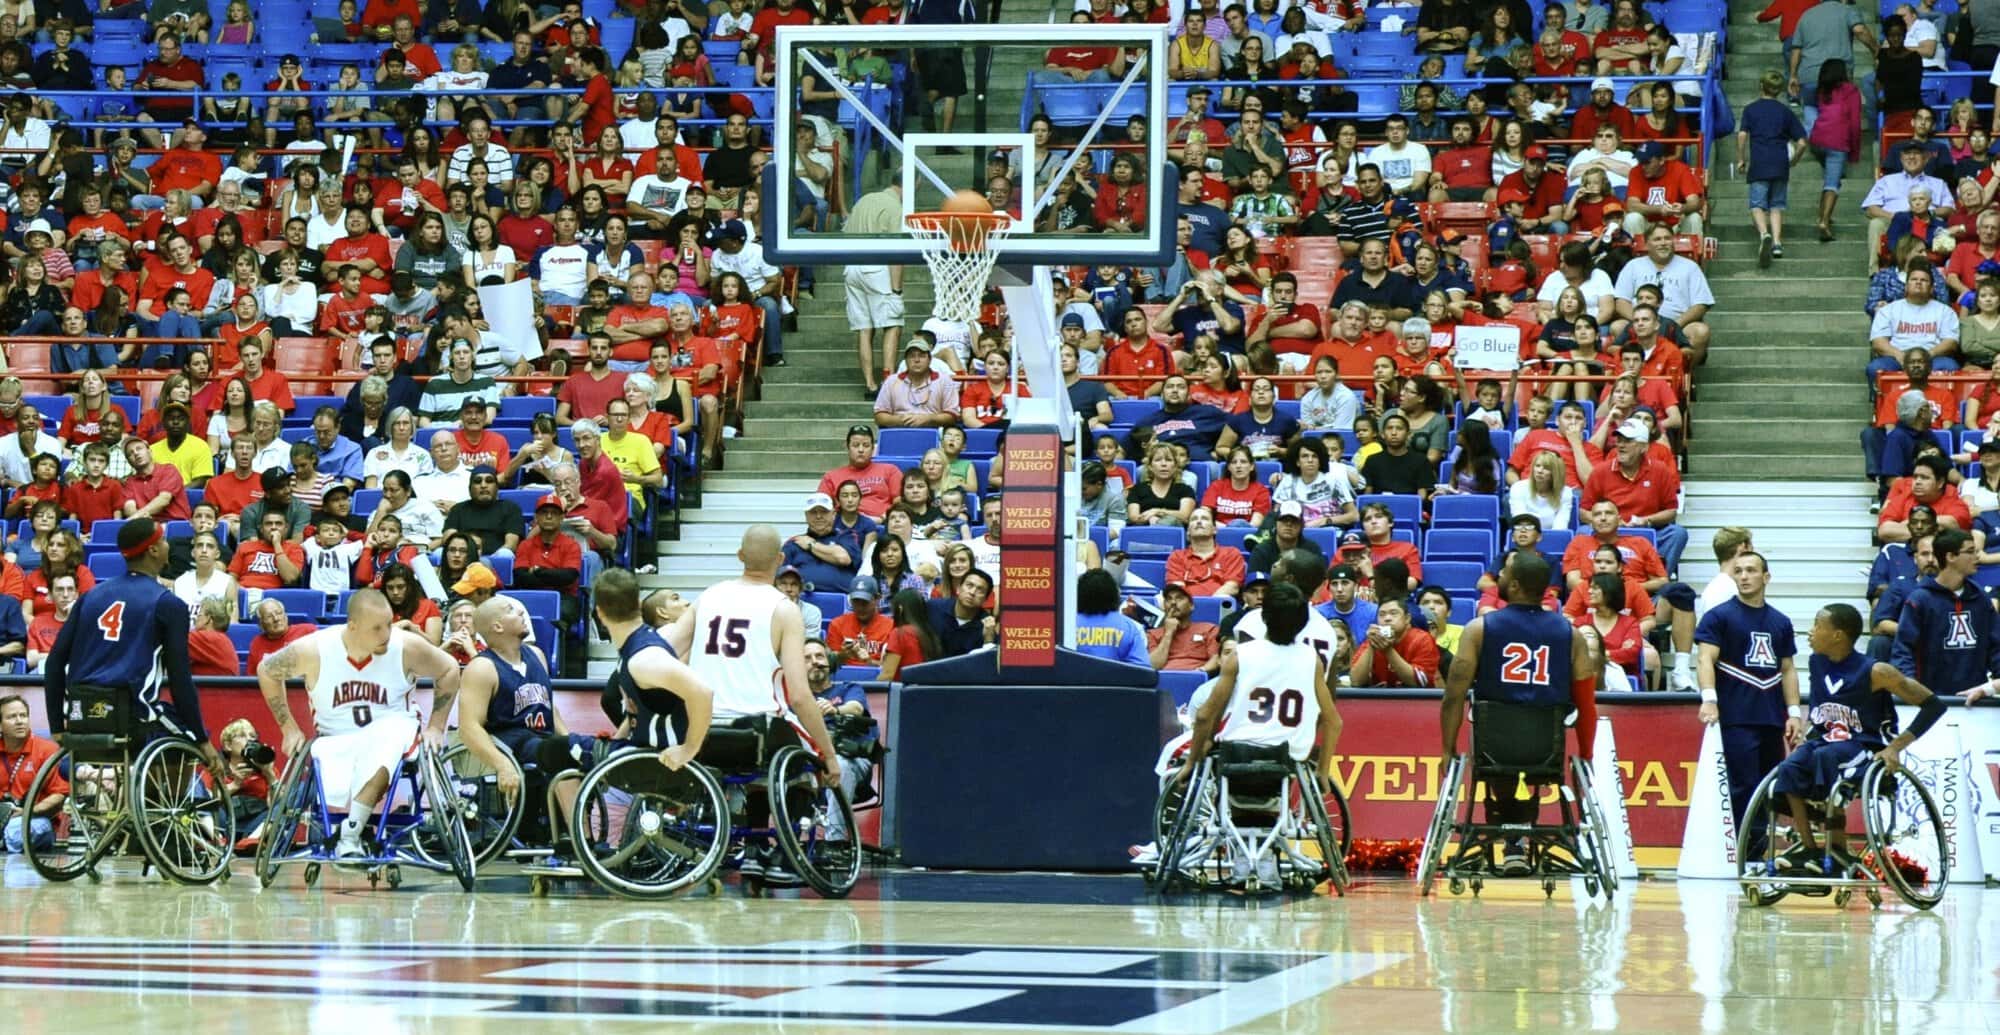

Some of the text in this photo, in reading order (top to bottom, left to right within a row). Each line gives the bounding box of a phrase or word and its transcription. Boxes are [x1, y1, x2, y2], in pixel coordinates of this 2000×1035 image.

[1897, 320, 1938, 335] ARIZONA
[1456, 338, 1517, 353] Go Blue
[1008, 449, 1056, 460] WELLS
[1008, 461, 1054, 471] FARGO
[1005, 508, 1053, 518] WELLS
[1005, 519, 1051, 529] FARGO
[247, 552, 278, 576] A
[318, 551, 341, 569] USA
[1004, 567, 1051, 577] WELLS
[1004, 579, 1050, 589] FARGO
[98, 600, 127, 642] 4
[704, 615, 751, 659] 15
[1004, 628, 1052, 638] WELLS
[1077, 626, 1125, 648] CURITY
[1943, 611, 1978, 650] A
[1004, 639, 1051, 650] FARGO
[1744, 631, 1778, 669] A
[1500, 642, 1551, 686] 21
[333, 679, 389, 709] ARIZONA
[1248, 686, 1304, 728] 30
